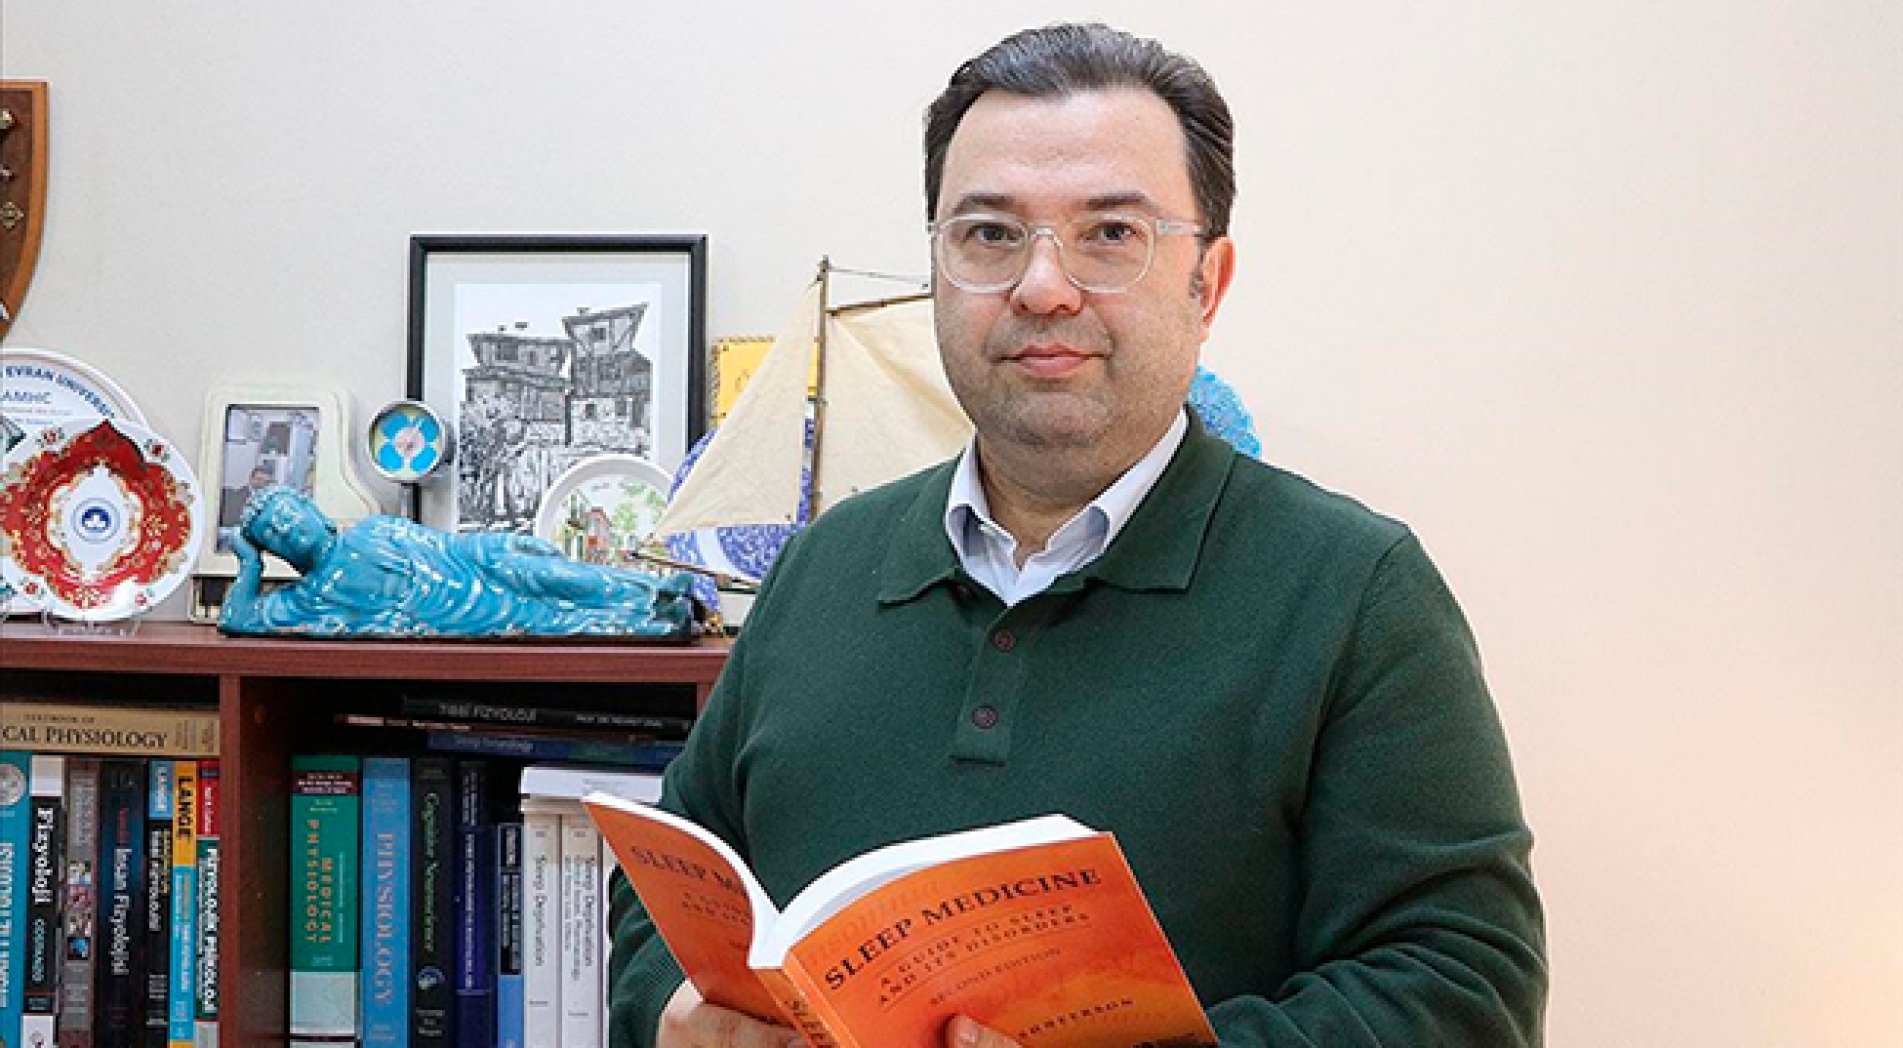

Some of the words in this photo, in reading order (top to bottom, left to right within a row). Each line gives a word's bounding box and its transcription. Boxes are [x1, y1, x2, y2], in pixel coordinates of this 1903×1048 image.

[5, 365, 54, 381] EVRAN
[46, 728, 167, 748] PHYSIOLOGY
[178, 777, 194, 838] LANGE
[32, 807, 54, 905] Fizyoloji
[306, 819, 320, 943] PHYSIOLOGY
[533, 855, 547, 890] Sleep
[582, 855, 595, 890] Sleep
[631, 846, 706, 880] SLEEP
[320, 858, 333, 943] MEDICAL
[375, 834, 394, 1005] PHYSIOLOGY
[533, 895, 547, 967] Deprivation
[583, 895, 596, 967] Deprivation
[825, 918, 911, 990] SLEEP
[921, 868, 1102, 926] MEDICINE
[880, 974, 917, 1005] AND
[924, 951, 956, 973] ITS
[966, 912, 1089, 952] DISORDERS
[898, 935, 958, 973] GUIDE
[973, 921, 1000, 937] TO
[1009, 903, 1071, 925] SLEEP
